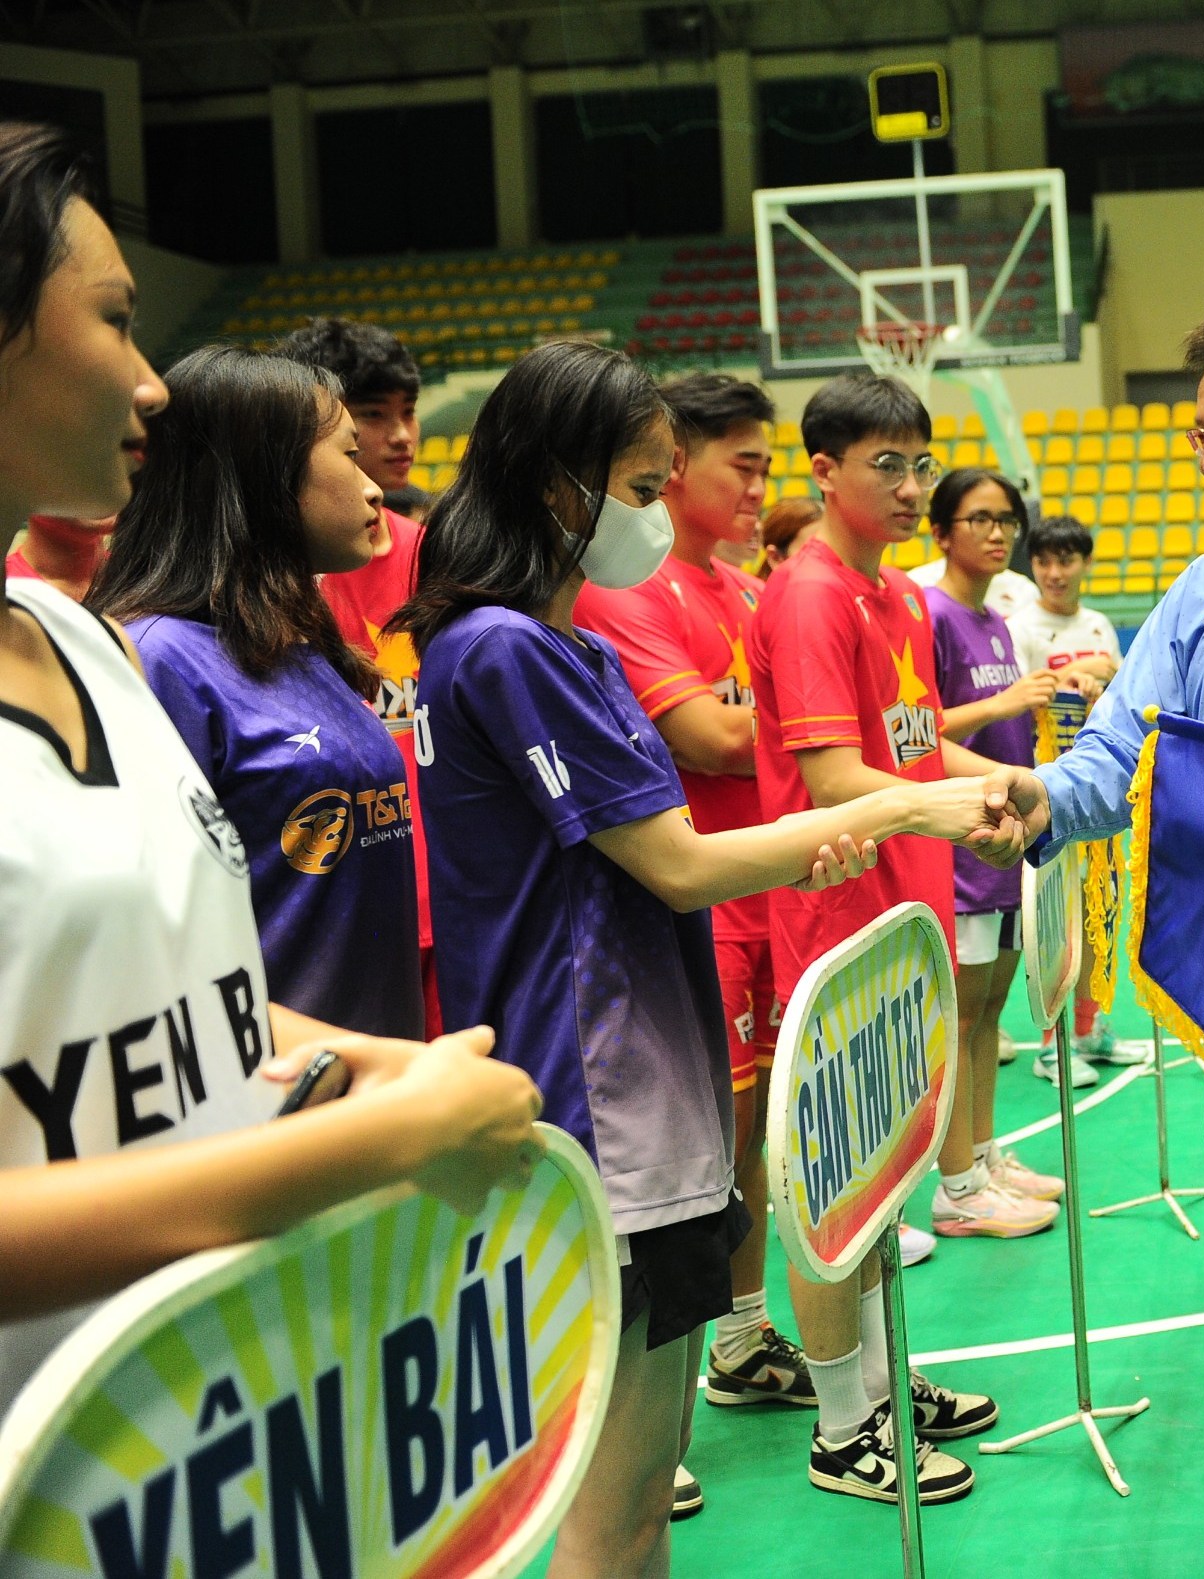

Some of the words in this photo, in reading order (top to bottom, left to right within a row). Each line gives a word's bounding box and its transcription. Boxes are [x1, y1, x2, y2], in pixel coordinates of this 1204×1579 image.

[0, 994, 207, 1164] YEN
[798, 1015, 853, 1227] CẦN
[849, 995, 892, 1166] THƠ
[890, 975, 929, 1119] T&T
[89, 1366, 354, 1579] YÊN
[380, 1231, 534, 1549] BÁI
